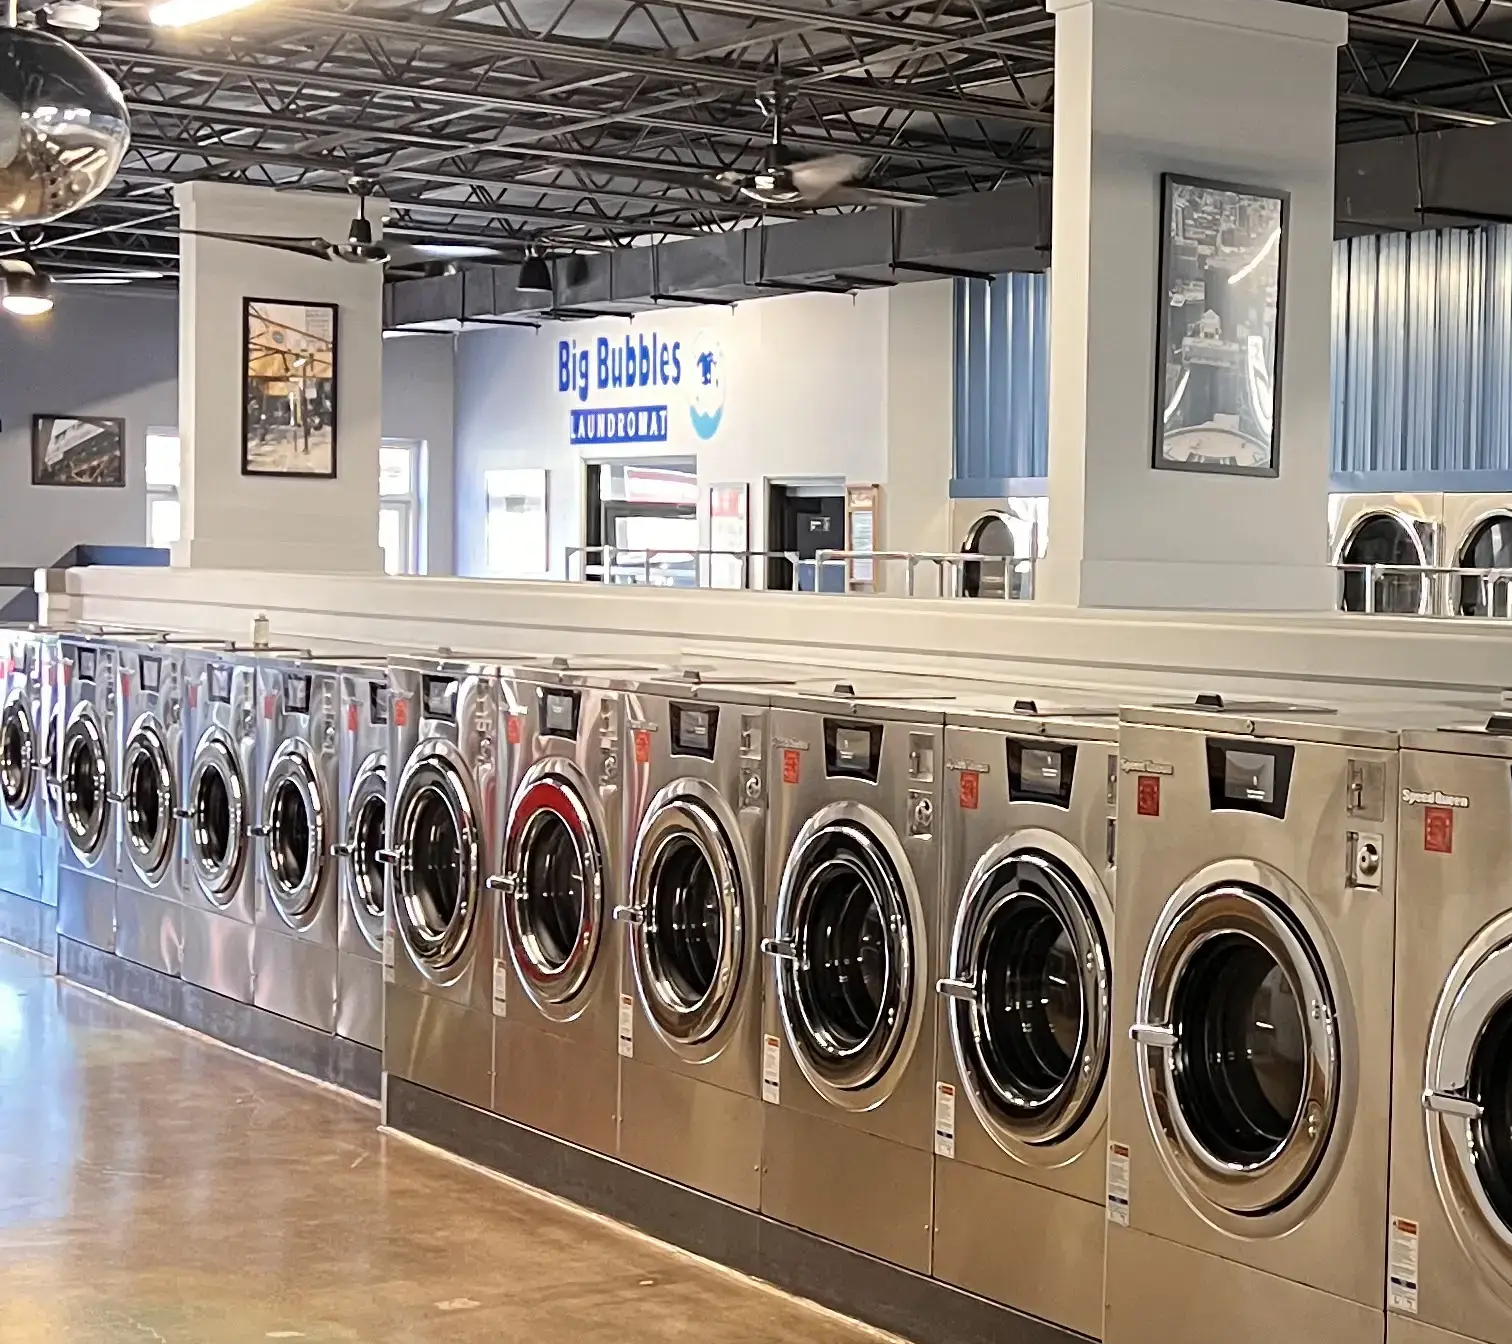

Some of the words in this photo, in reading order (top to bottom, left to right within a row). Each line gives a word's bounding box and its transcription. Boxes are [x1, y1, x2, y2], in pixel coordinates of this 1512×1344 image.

[559, 339, 589, 402] Big
[597, 332, 681, 390] Bubbles
[570, 410, 667, 439] LAUNDROMAT
